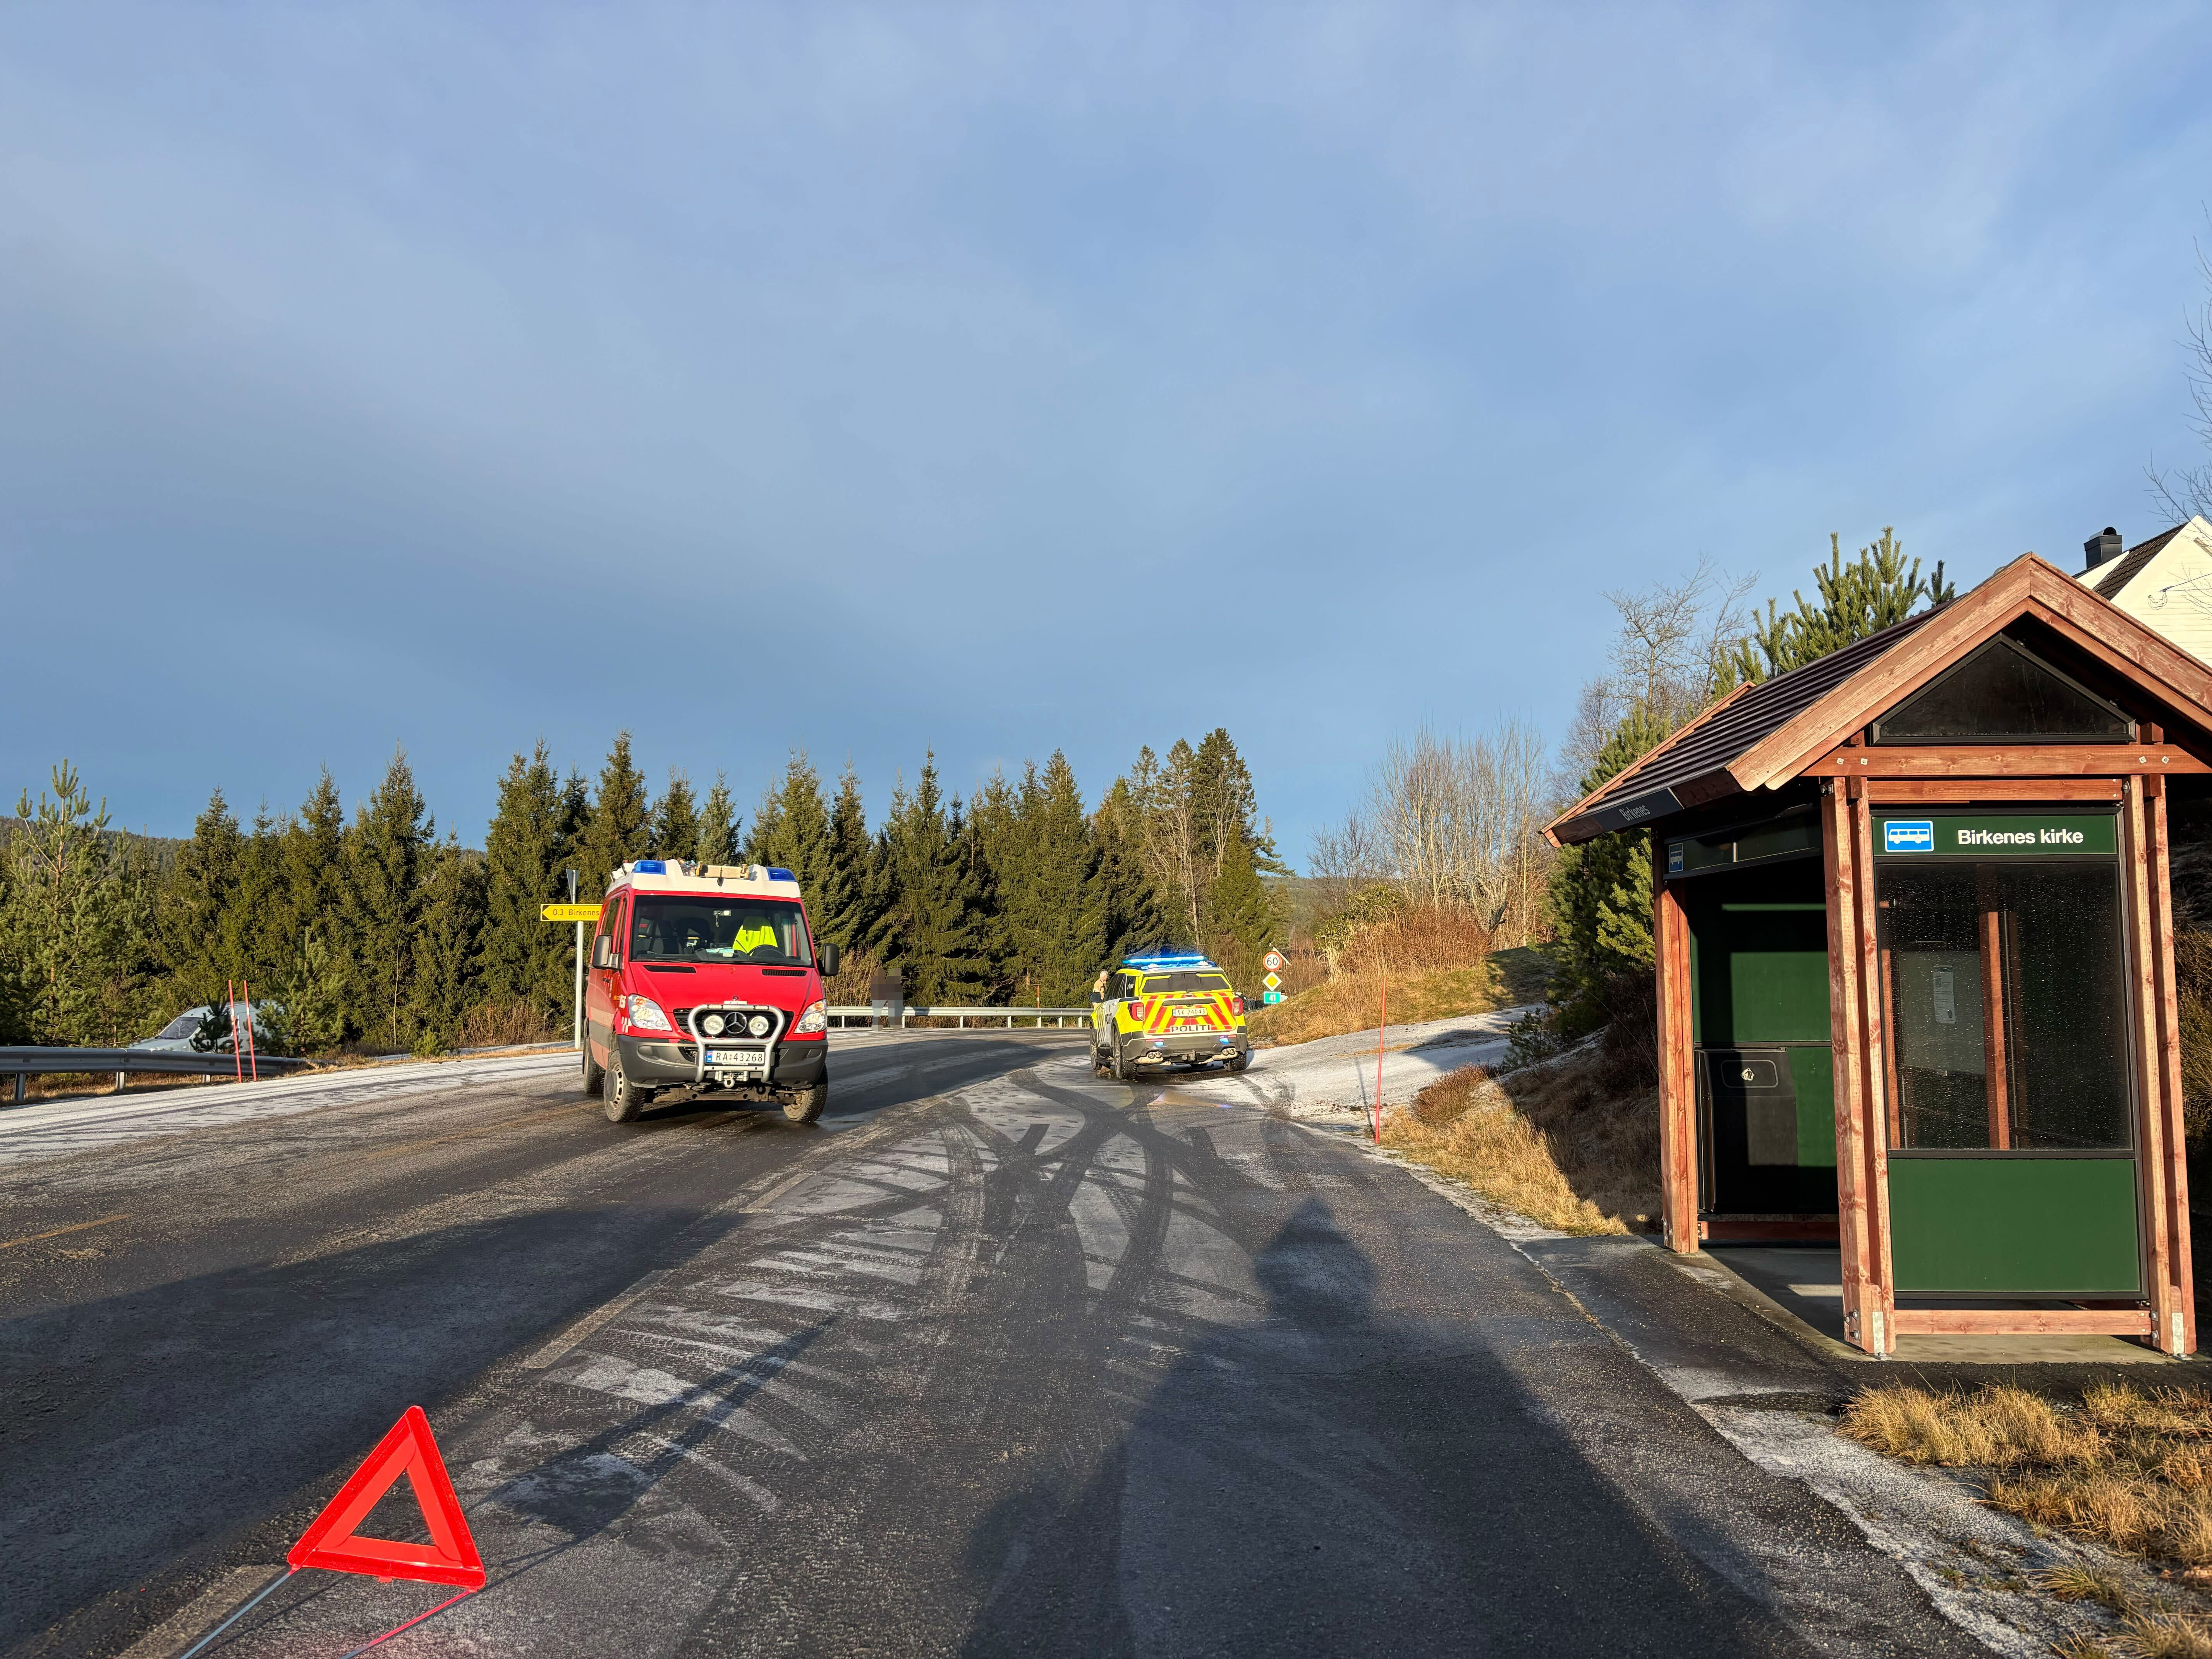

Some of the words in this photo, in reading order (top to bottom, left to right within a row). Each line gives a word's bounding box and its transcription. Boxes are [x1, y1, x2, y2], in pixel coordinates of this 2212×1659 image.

[1619, 805, 1650, 821] Birkenes
[1958, 830, 2036, 845] Birkenes
[2040, 828, 2083, 844] kirke
[1267, 957, 1278, 966] 60
[1269, 994, 1276, 1002] 41
[716, 1052, 728, 1061] RA
[733, 1053, 763, 1062] 43268
